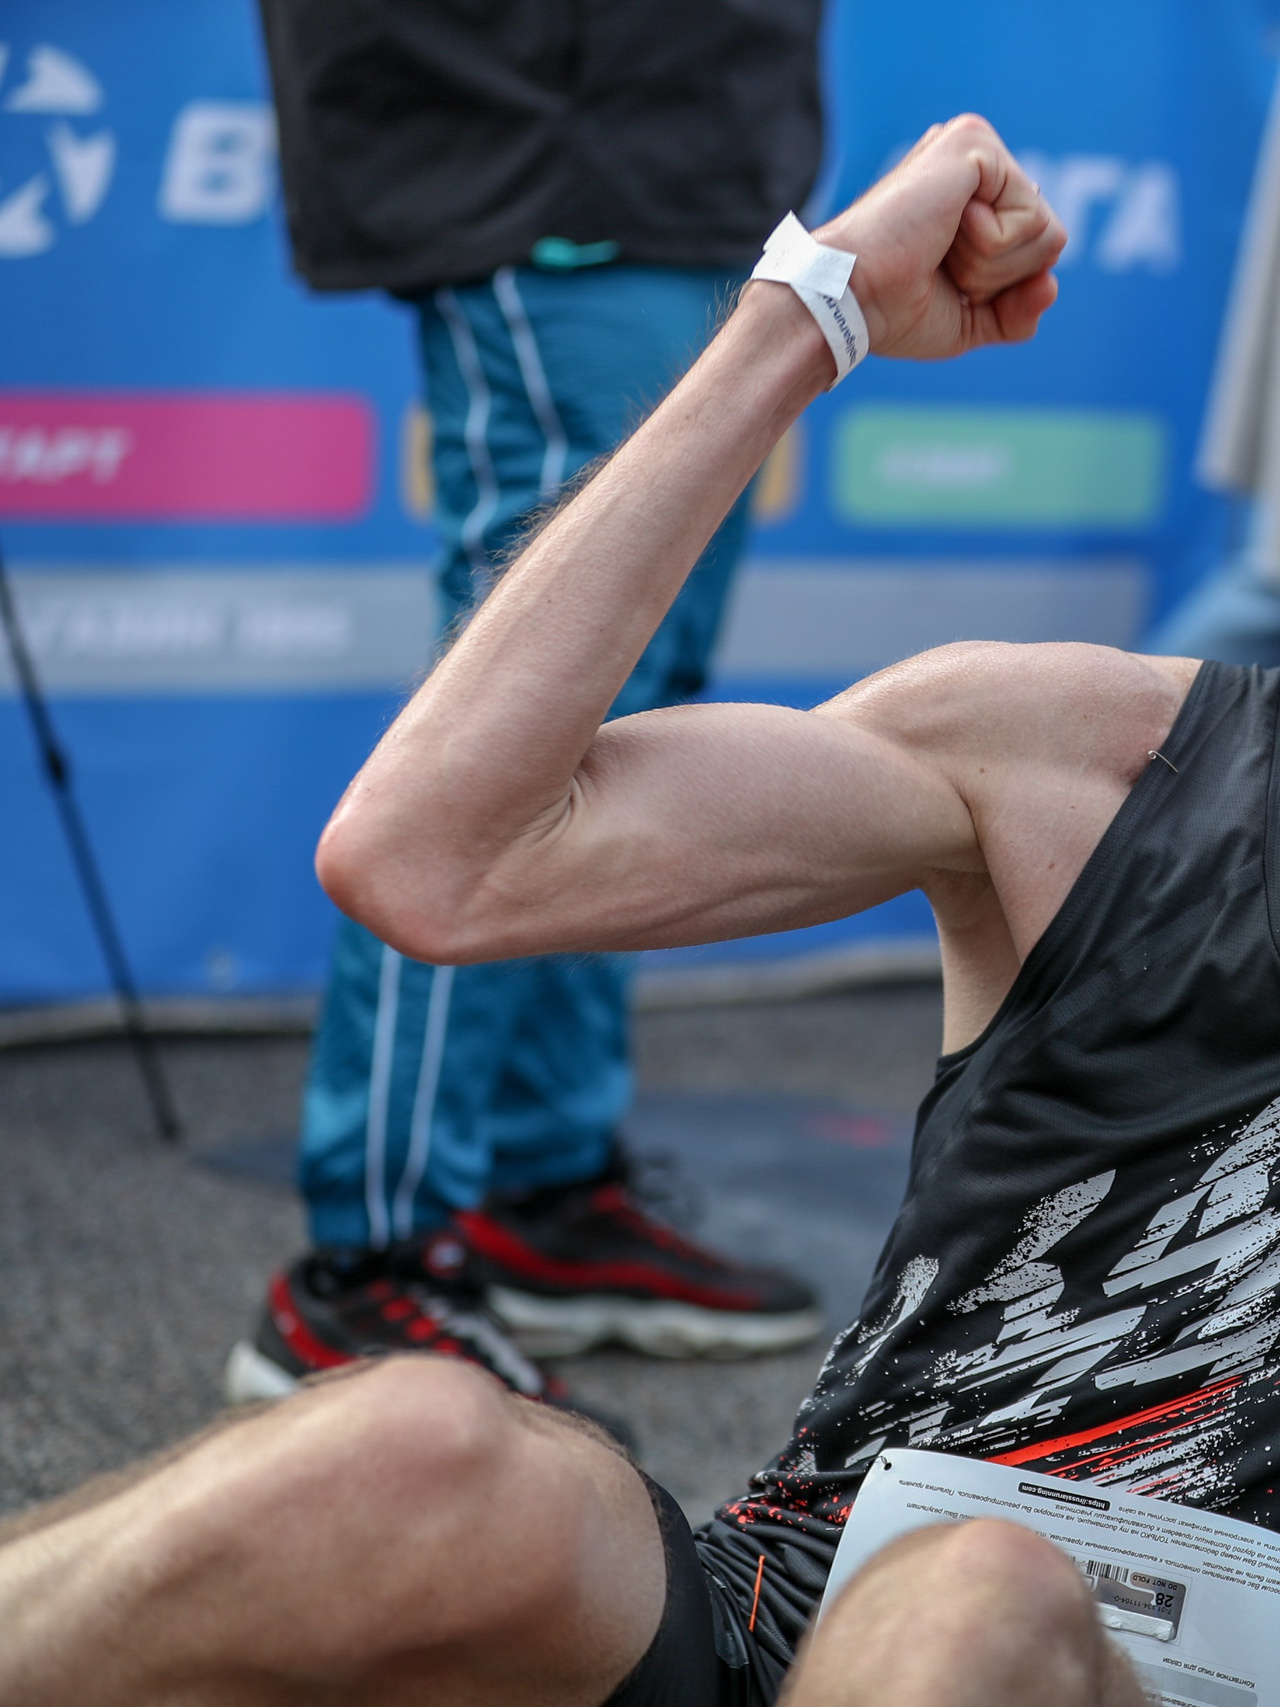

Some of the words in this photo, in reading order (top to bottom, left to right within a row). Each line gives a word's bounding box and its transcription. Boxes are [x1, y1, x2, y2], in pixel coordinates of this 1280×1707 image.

[924, 1484, 955, 1496] Попытка
[1021, 1485, 1105, 1509] https://russiarunning.com
[906, 1502, 943, 1514] результат
[1020, 1505, 1032, 1513] Вы
[1033, 1507, 1064, 1518] которую
[1118, 1506, 1136, 1514] сайте
[942, 1509, 958, 1519] Ваш
[1146, 1512, 1177, 1523] доступны
[1118, 1525, 1129, 1533] ту
[1139, 1531, 1168, 1543] ТОЛЬКО
[1169, 1538, 1219, 1556] действителен
[1193, 1536, 1231, 1551] дистанции
[1219, 1550, 1242, 1561] номер
[1231, 1545, 1256, 1557] другой
[1164, 1559, 1201, 1573] отнестись
[1201, 1560, 1234, 1573] засчитан.
[1241, 1557, 1257, 1566] Вам
[1132, 1574, 1150, 1583] FOLD
[1201, 1569, 1246, 1585] внимательно
[1245, 1572, 1264, 1582] быть
[1152, 1579, 1166, 1587] NOT
[1167, 1582, 1177, 1590] DO
[1246, 1581, 1260, 1590] Вас
[1155, 1592, 1174, 1607] 28
[1162, 1657, 1182, 1667] связи
[1183, 1663, 1197, 1671] для
[1197, 1666, 1215, 1676] лицо
[1215, 1672, 1255, 1689] Контактное
